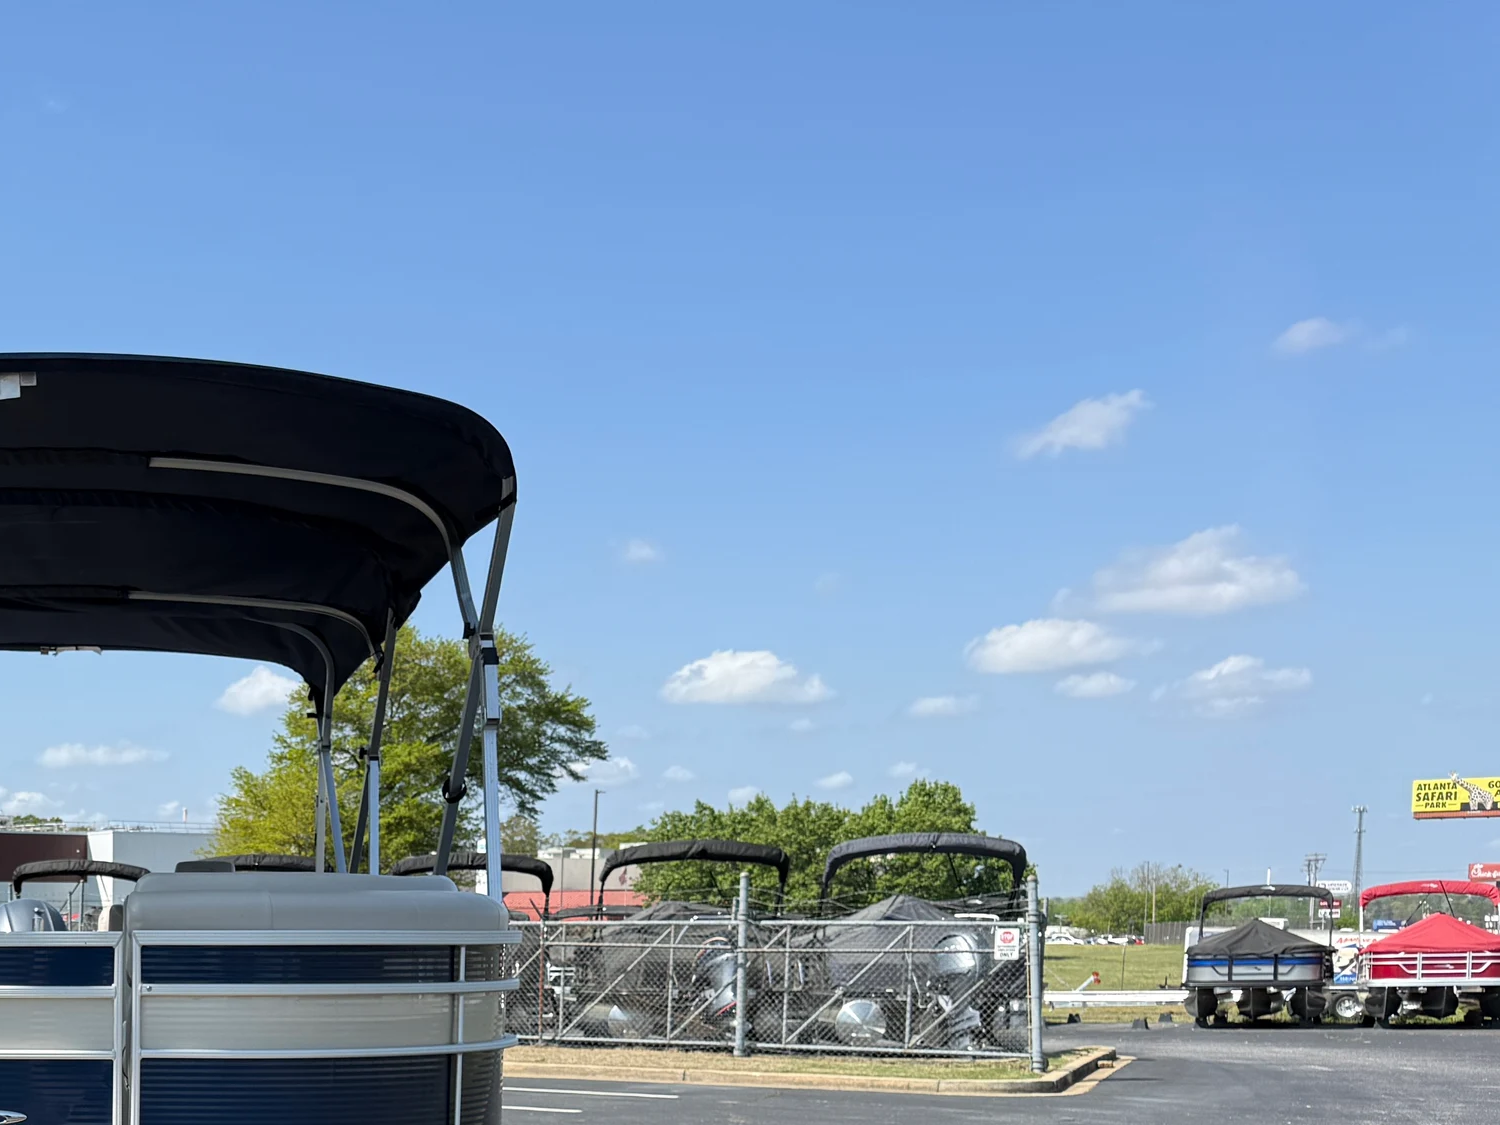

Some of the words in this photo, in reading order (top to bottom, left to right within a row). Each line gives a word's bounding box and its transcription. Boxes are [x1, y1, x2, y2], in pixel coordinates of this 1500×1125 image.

[1416, 782, 1458, 791] ATLANTA
[1415, 791, 1458, 802] SAFARI
[1424, 801, 1447, 809] PARK
